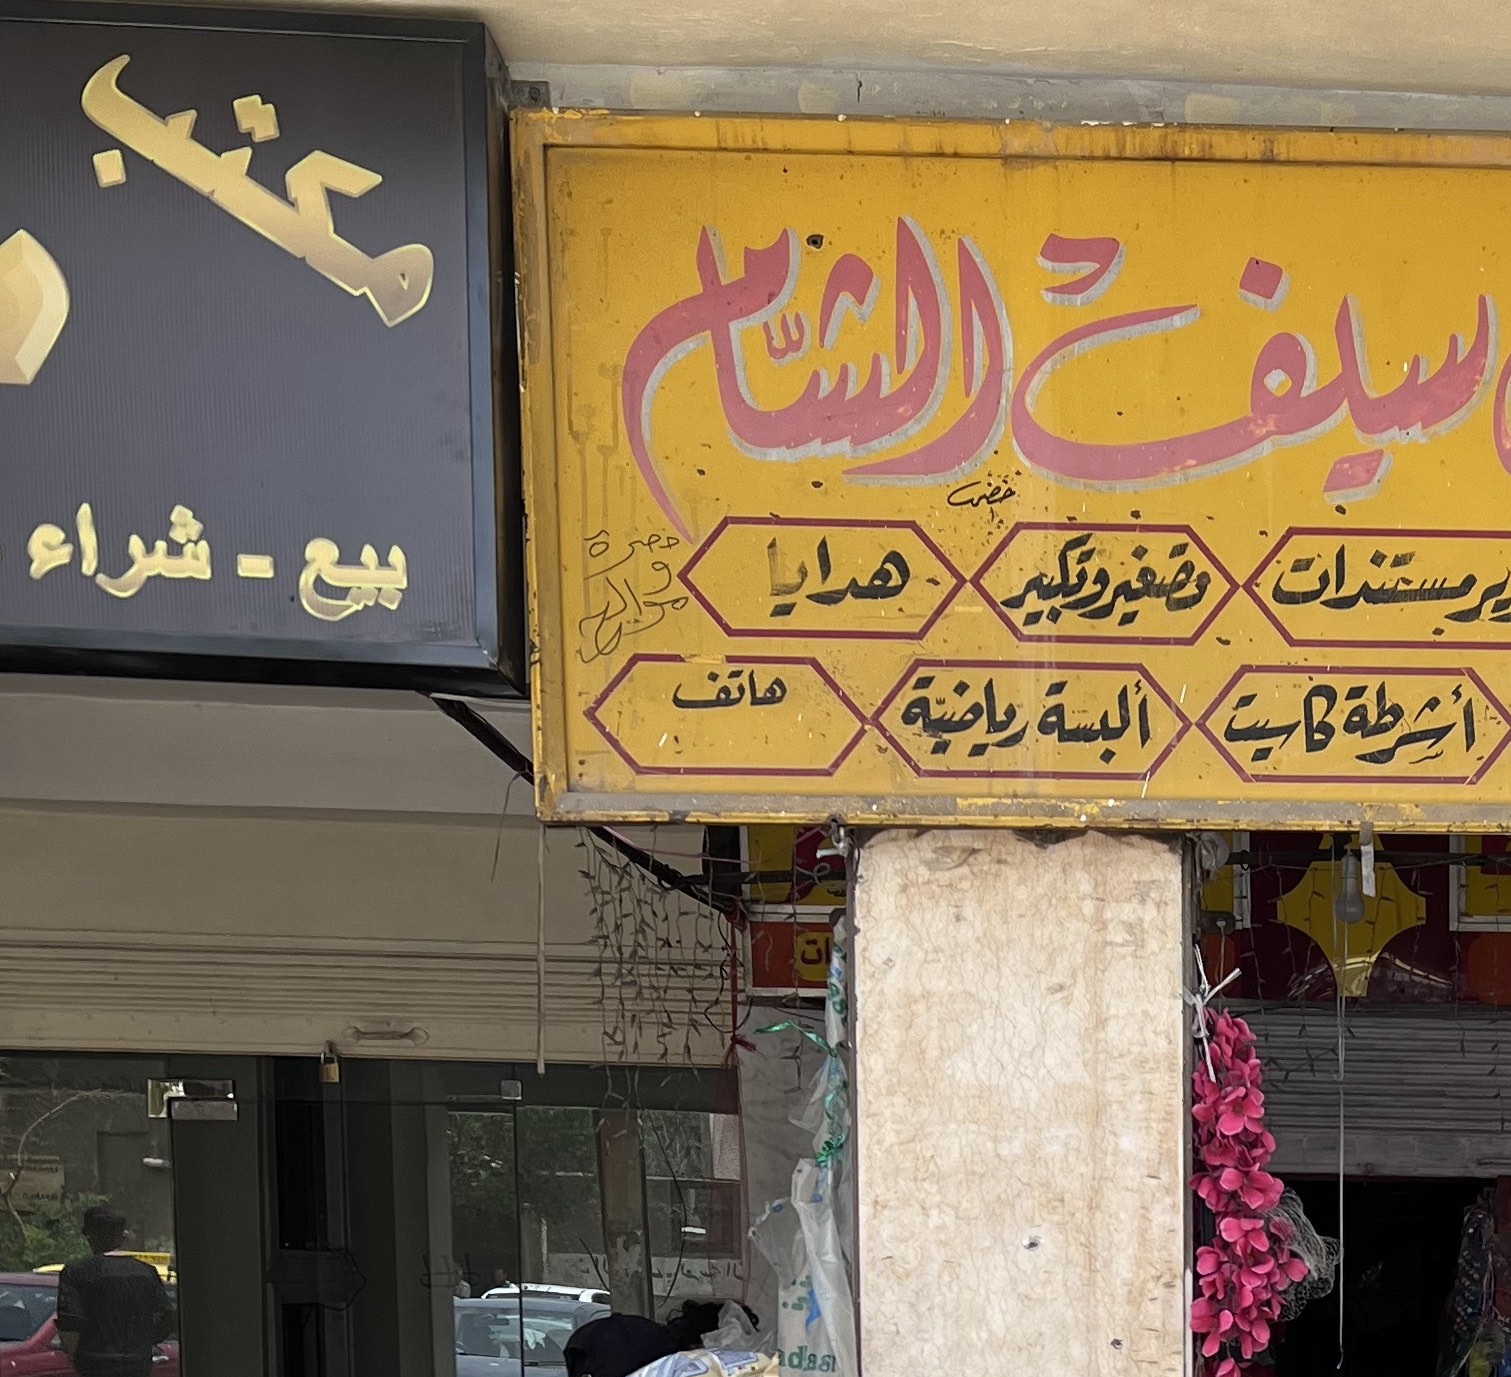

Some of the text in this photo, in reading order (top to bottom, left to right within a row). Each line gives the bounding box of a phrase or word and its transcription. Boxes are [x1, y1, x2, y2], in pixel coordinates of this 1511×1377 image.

[1012, 233, 1497, 505] سيف
[26, 501, 212, 599] شراء
[299, 535, 409, 621] بيع
[765, 534, 911, 618] هدايا
[1271, 543, 1478, 611] مستندات
[671, 668, 789, 711] هاتف
[1036, 677, 1151, 764] ألبسة
[1223, 680, 1477, 768] أشرطة كاسيت
